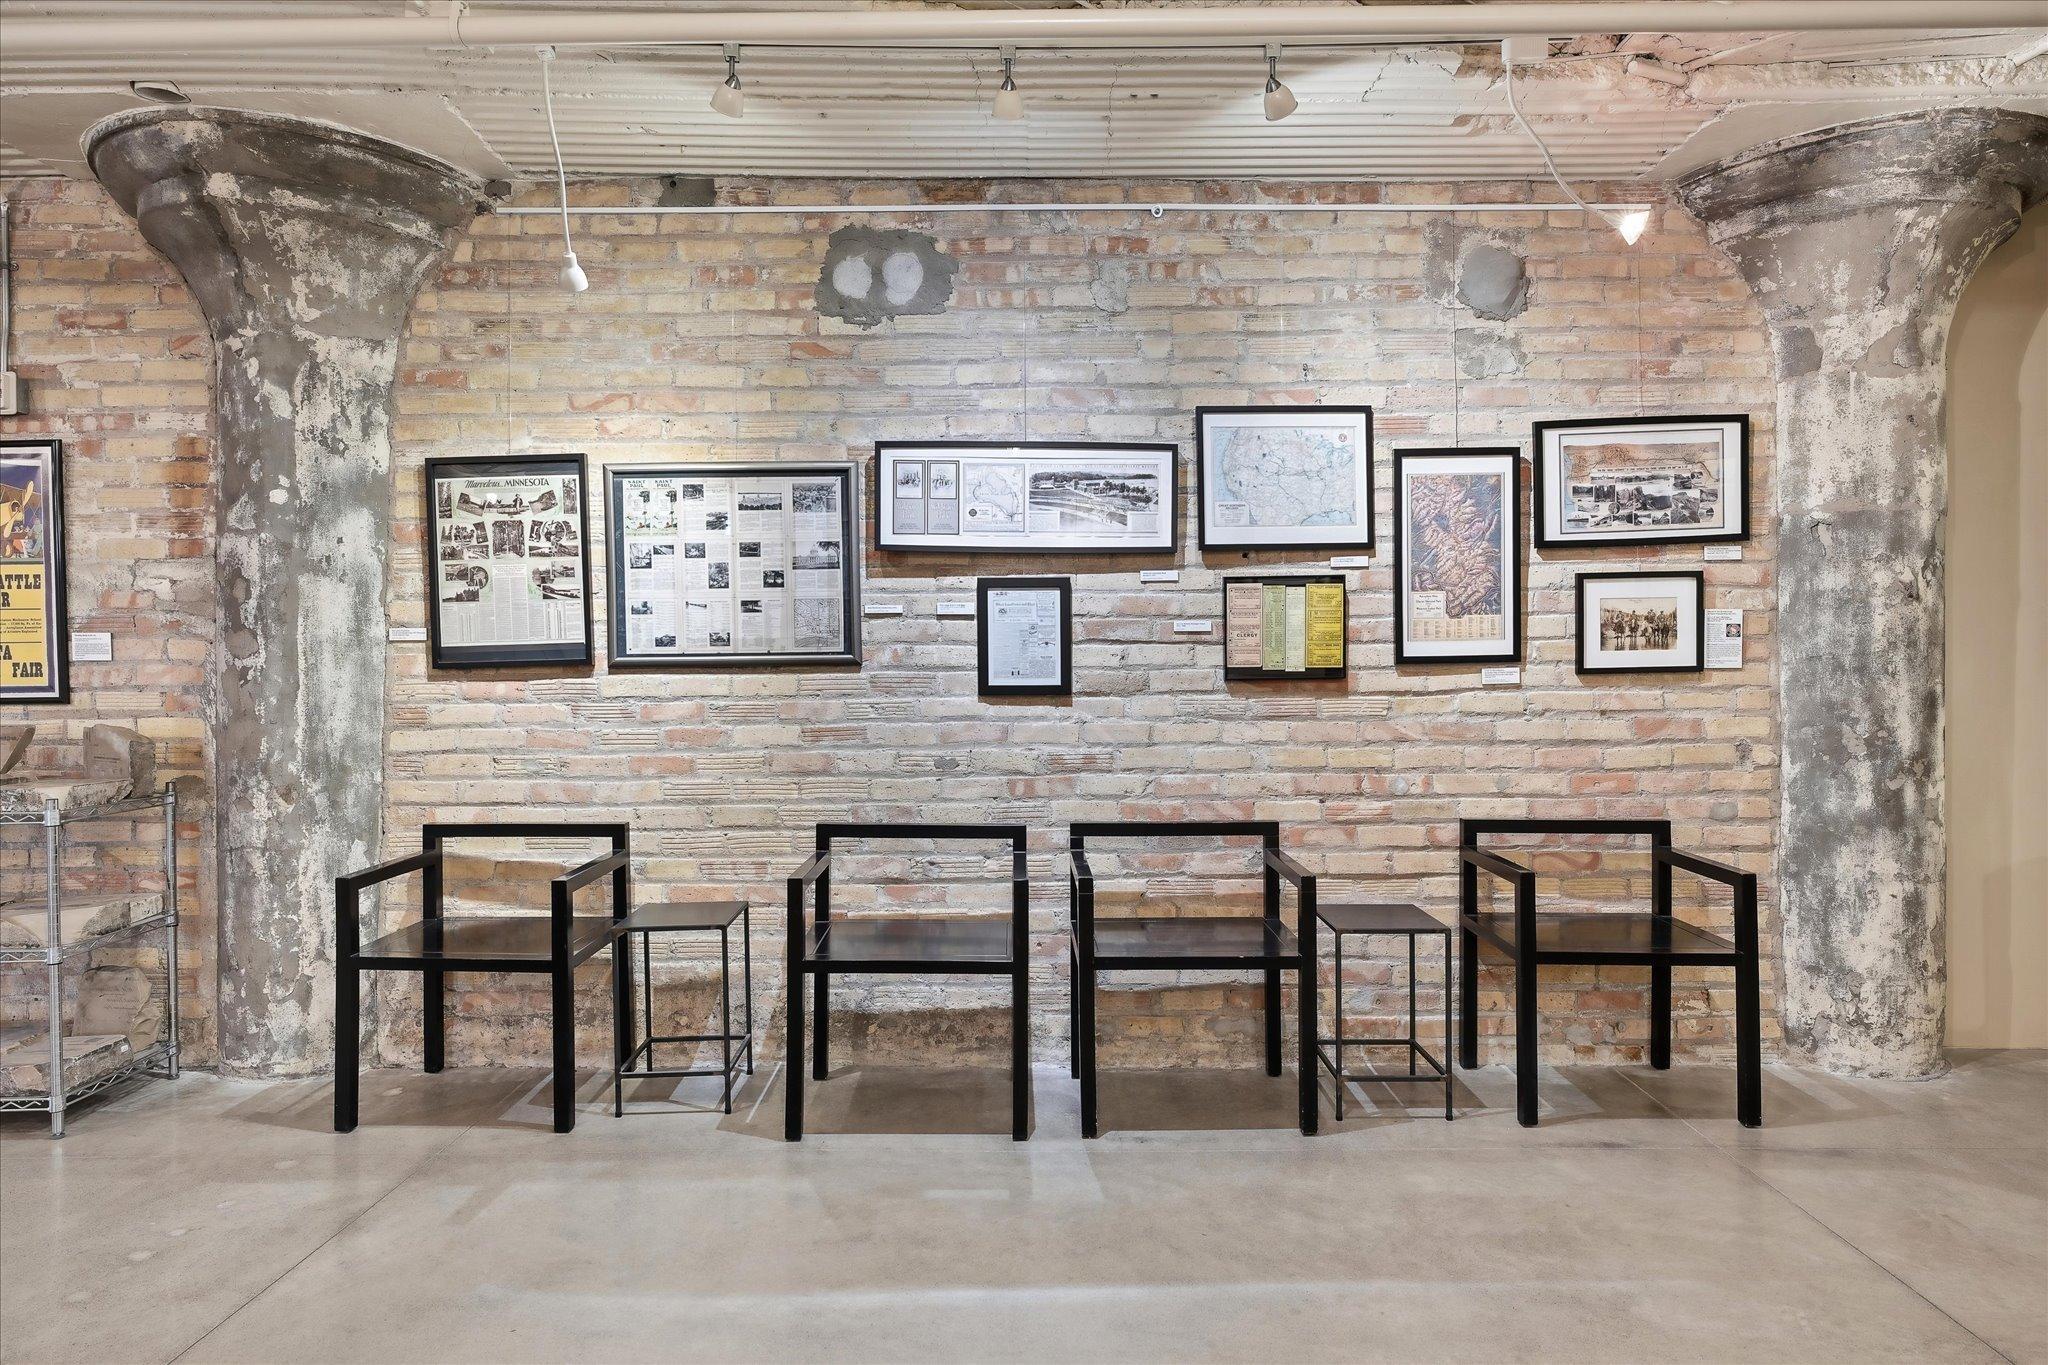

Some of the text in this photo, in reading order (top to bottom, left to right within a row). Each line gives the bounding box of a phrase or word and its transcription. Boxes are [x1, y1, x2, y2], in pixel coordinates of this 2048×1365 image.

[504, 478, 549, 487] MINNESOTA
[0, 645, 12, 660] A
[12, 662, 43, 677] FAIR
